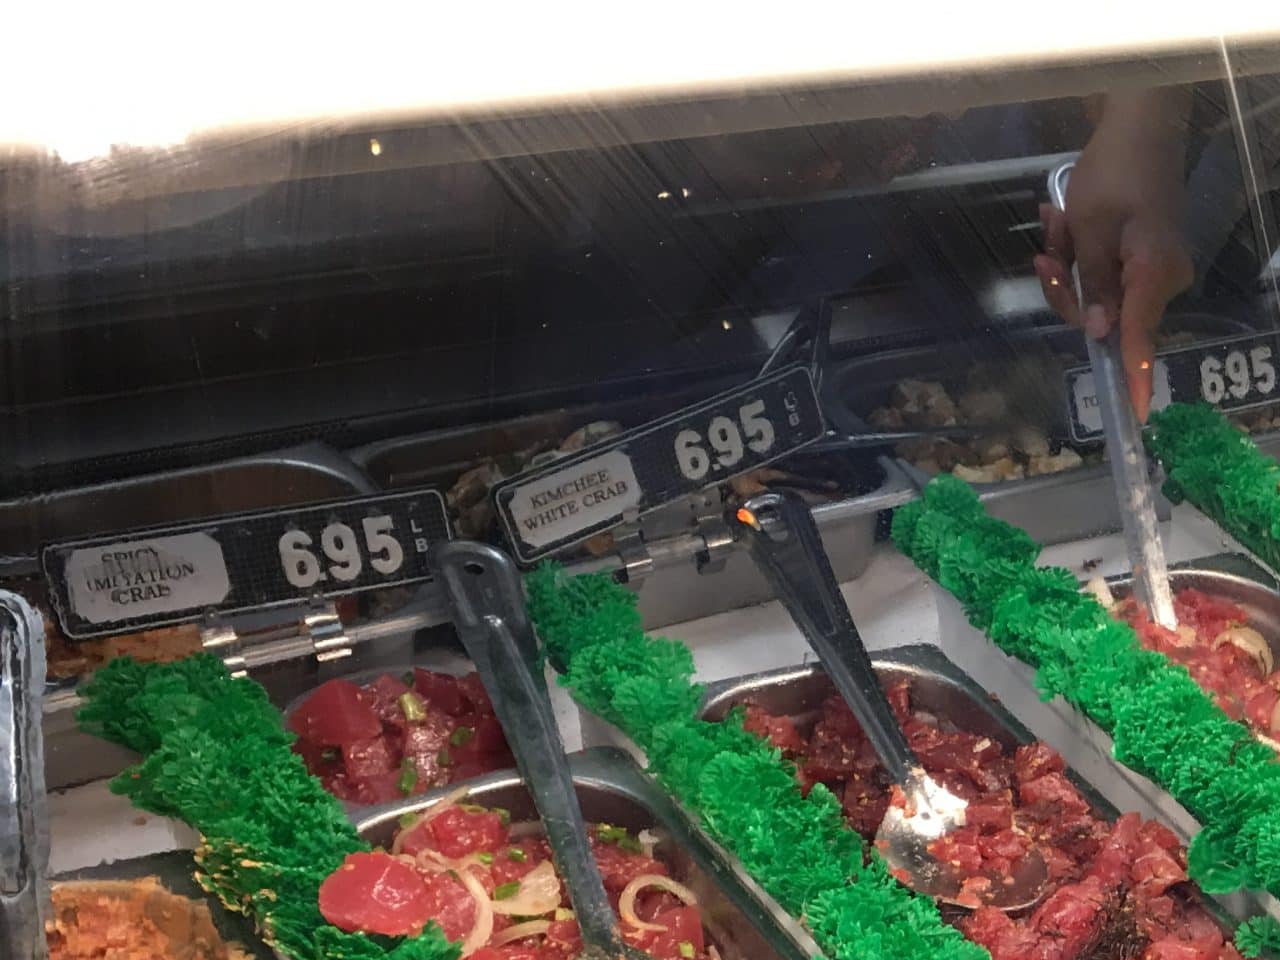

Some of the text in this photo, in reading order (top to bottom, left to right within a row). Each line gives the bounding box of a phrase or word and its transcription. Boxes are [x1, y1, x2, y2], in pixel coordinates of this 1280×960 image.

[524, 480, 629, 531] WHITE CRAB
[530, 469, 609, 509] KIMCHEE
